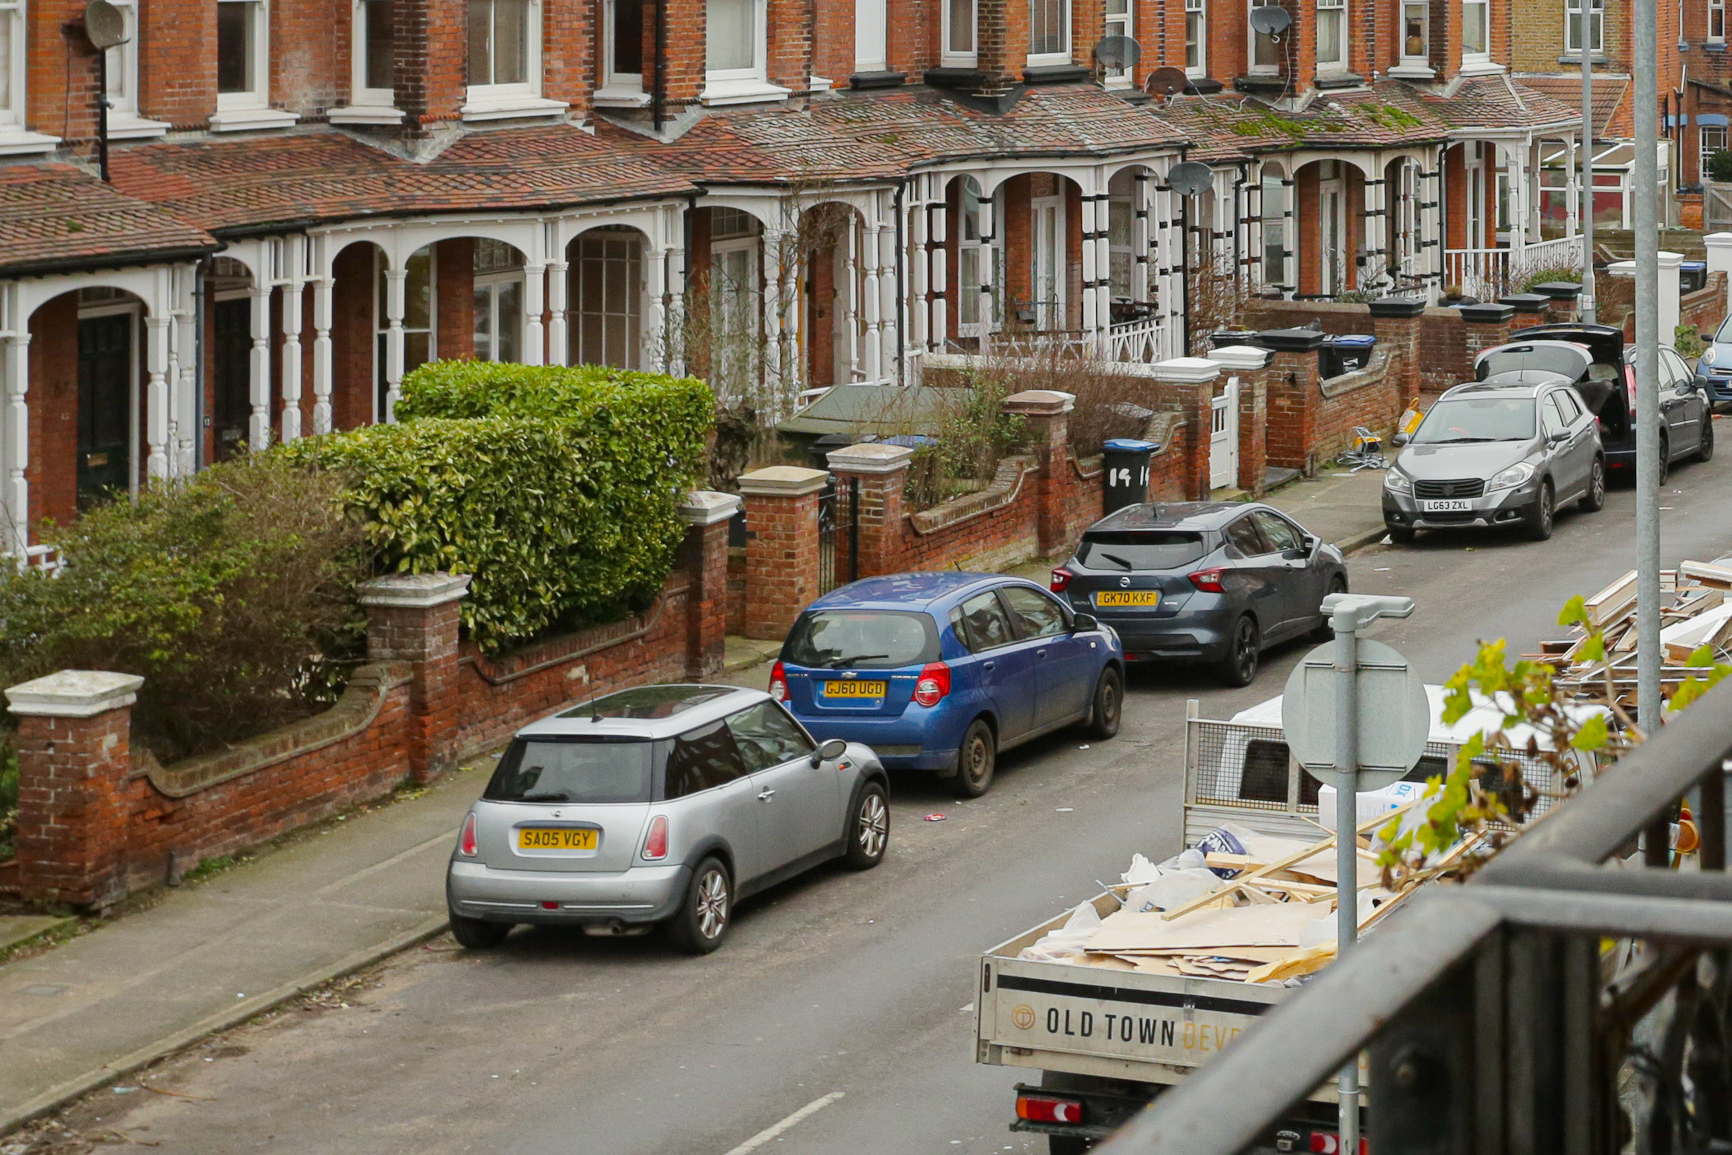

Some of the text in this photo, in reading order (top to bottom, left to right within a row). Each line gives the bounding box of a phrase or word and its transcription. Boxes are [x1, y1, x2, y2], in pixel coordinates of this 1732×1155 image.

[1428, 501, 1468, 510] LG63 ZXL
[1104, 593, 1152, 603] GK70 KXF
[826, 683, 882, 694] GJ60 UGD
[524, 832, 591, 846] SA05 VGY
[1047, 1007, 1093, 1037] OLD
[1105, 1014, 1175, 1047] TOWN
